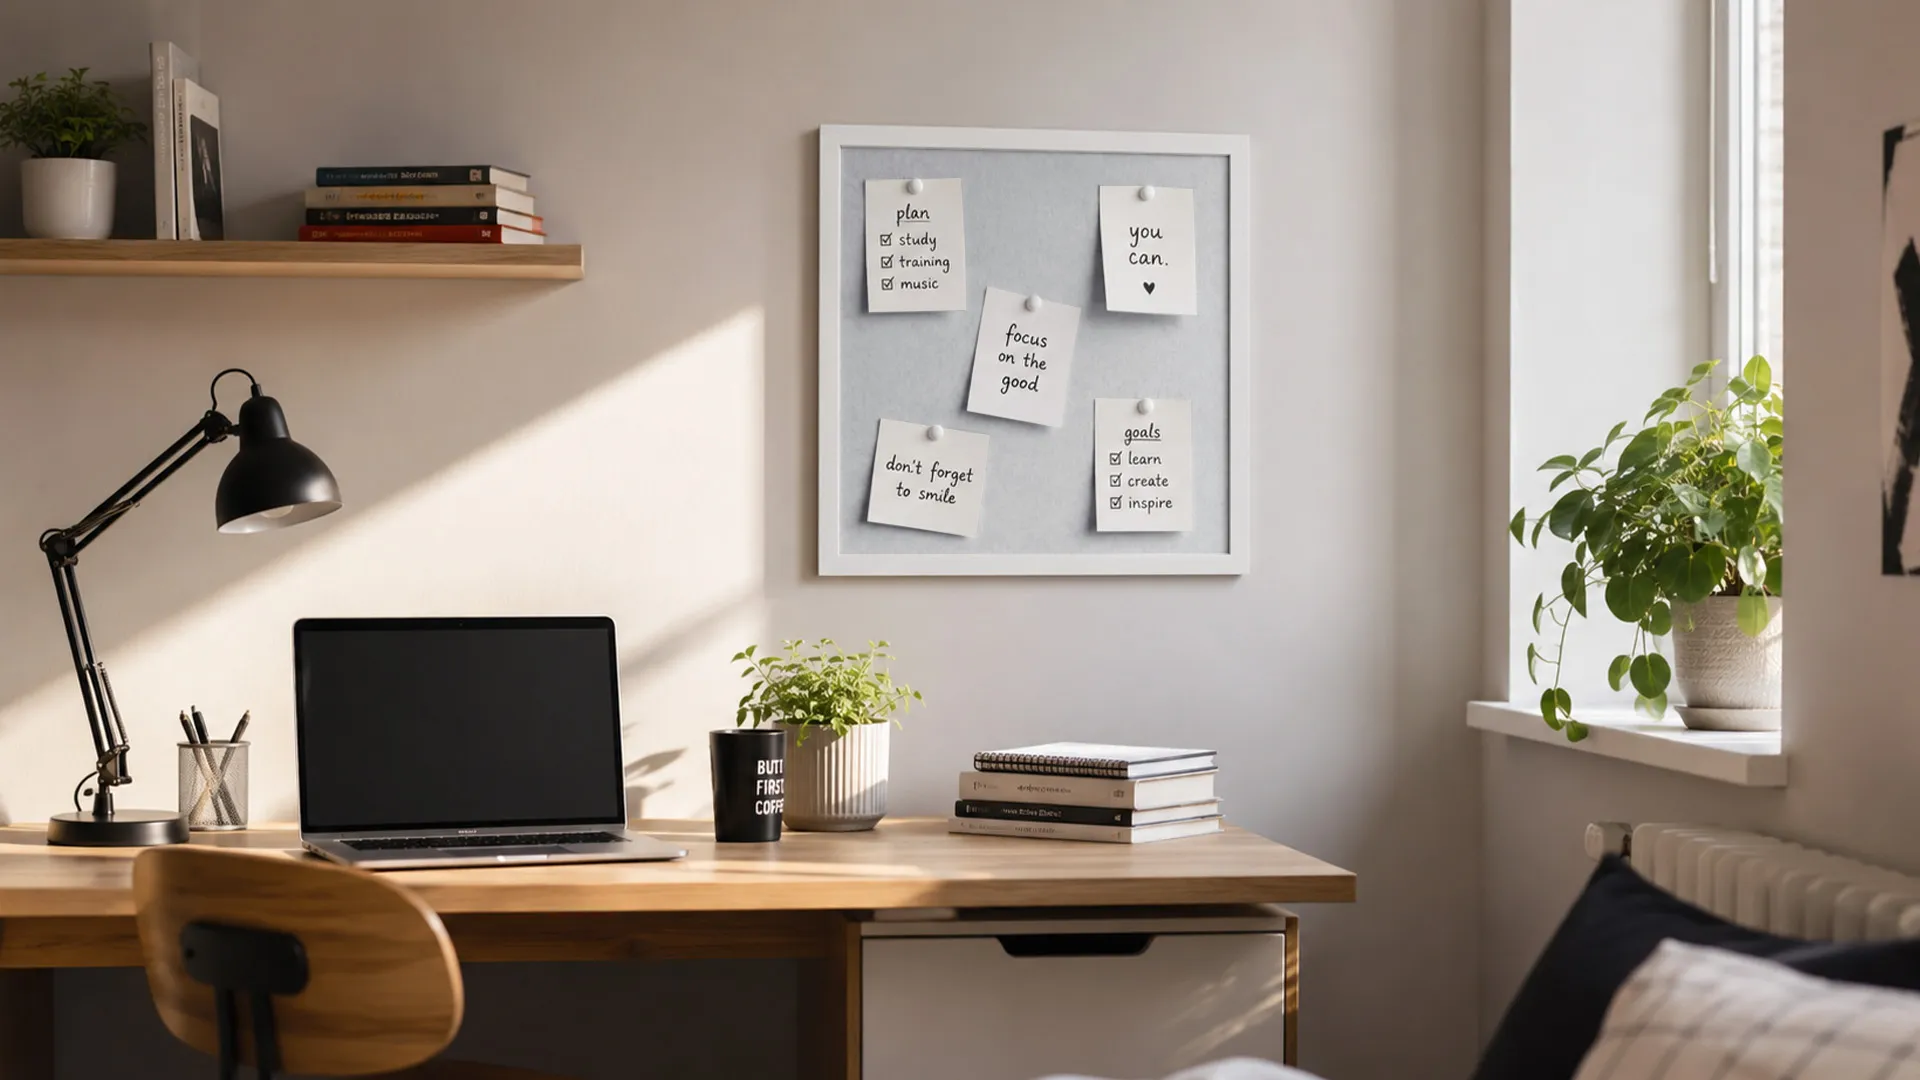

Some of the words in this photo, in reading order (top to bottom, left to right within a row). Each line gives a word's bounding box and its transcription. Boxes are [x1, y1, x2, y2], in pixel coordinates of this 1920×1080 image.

[896, 203, 930, 226] plan
[899, 232, 937, 252] study
[1129, 227, 1163, 248] you
[899, 256, 950, 273] training
[1129, 252, 1169, 266] can.
[900, 277, 939, 290] music
[1005, 323, 1048, 348] focus
[998, 352, 1015, 365] on
[1023, 353, 1047, 370] the
[1000, 375, 1040, 395] good
[1124, 422, 1161, 446] goals
[1128, 451, 1162, 466] learn
[885, 454, 922, 475] don't
[930, 461, 974, 487] forget
[1128, 473, 1169, 488] create
[896, 482, 910, 498] to
[918, 486, 957, 504] smile
[1128, 497, 1173, 514] inspire
